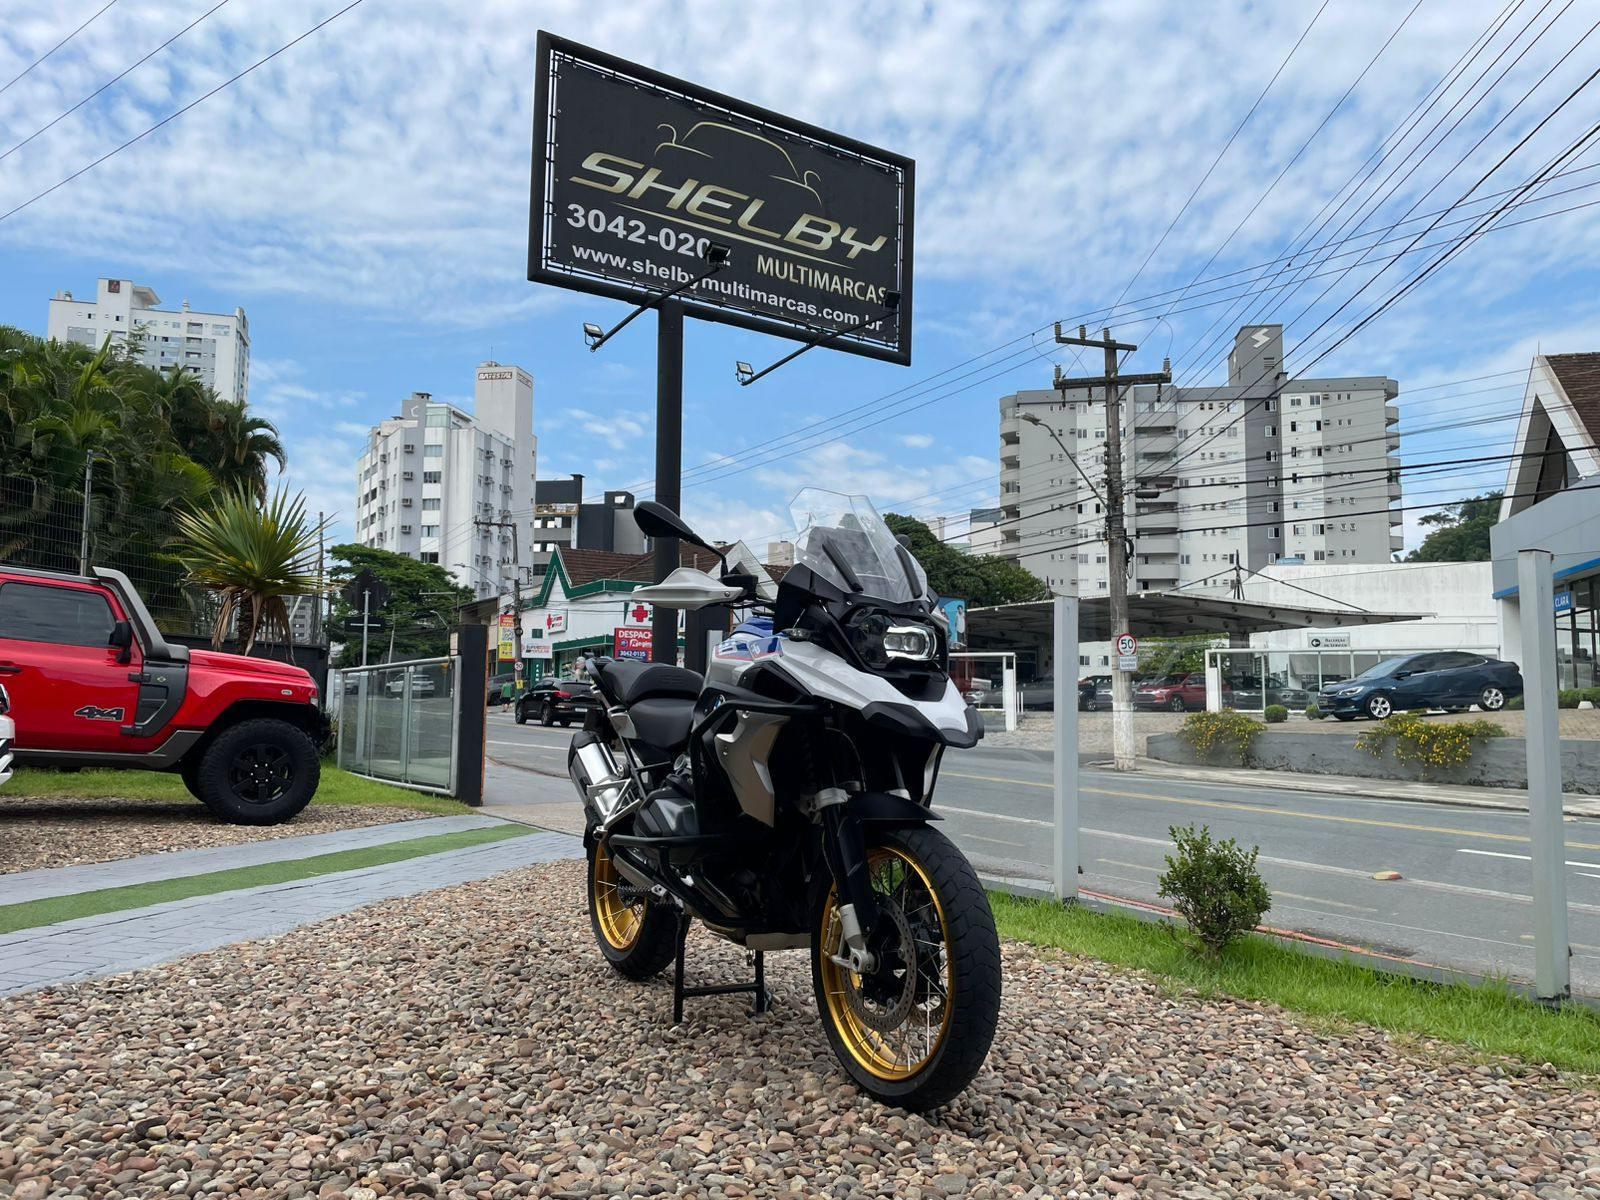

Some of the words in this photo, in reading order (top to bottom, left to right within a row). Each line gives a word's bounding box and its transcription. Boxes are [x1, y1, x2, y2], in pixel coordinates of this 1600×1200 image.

[569, 152, 888, 259] SHELBY
[566, 203, 731, 266] 3042-020
[572, 244, 883, 331] www.shelbymultimarcas.combr
[756, 254, 887, 304] MULTIMARCAS
[1555, 596, 1569, 607] CLARA
[1120, 638, 1134, 649] 50
